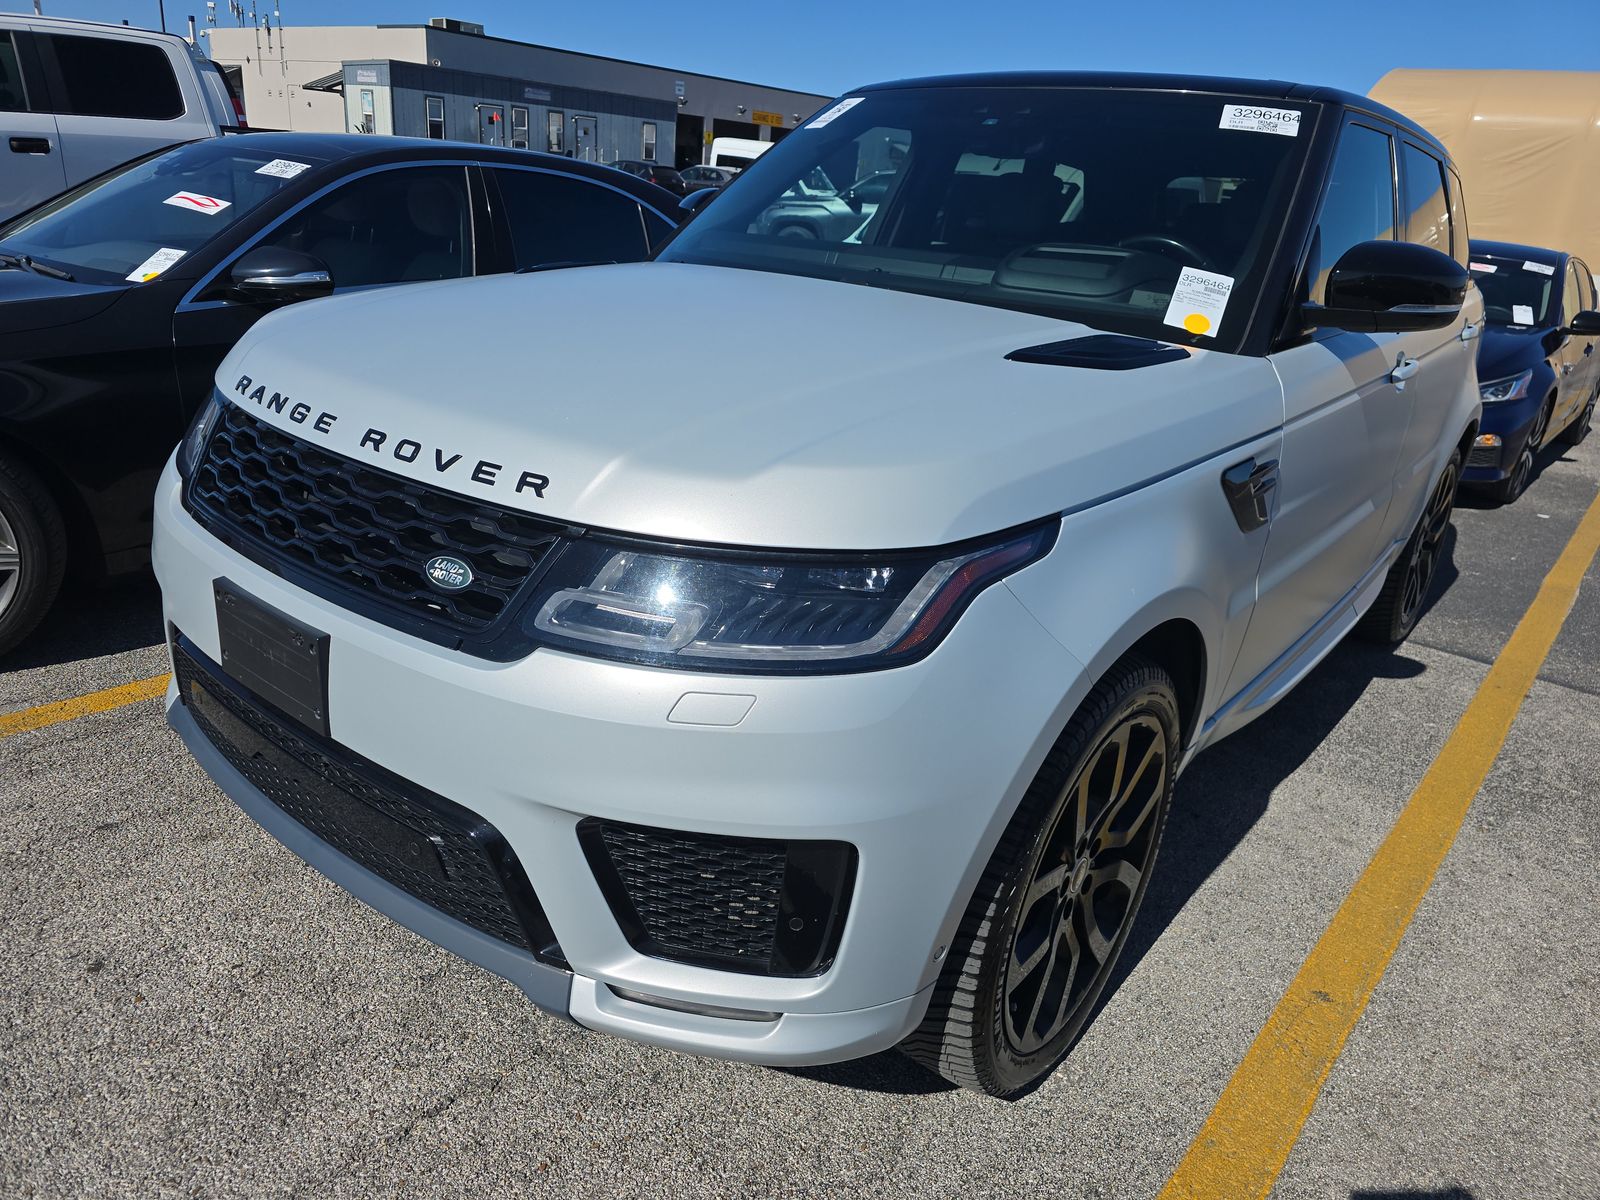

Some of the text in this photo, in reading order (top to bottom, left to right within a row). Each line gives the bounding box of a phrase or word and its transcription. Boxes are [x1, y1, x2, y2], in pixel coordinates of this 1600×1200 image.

[1233, 108, 1301, 123] 3296464
[1182, 273, 1231, 291] 3296464
[234, 374, 551, 499] RANGE ROVER
[434, 558, 460, 573] LAND
[432, 568, 463, 585] ROVER
